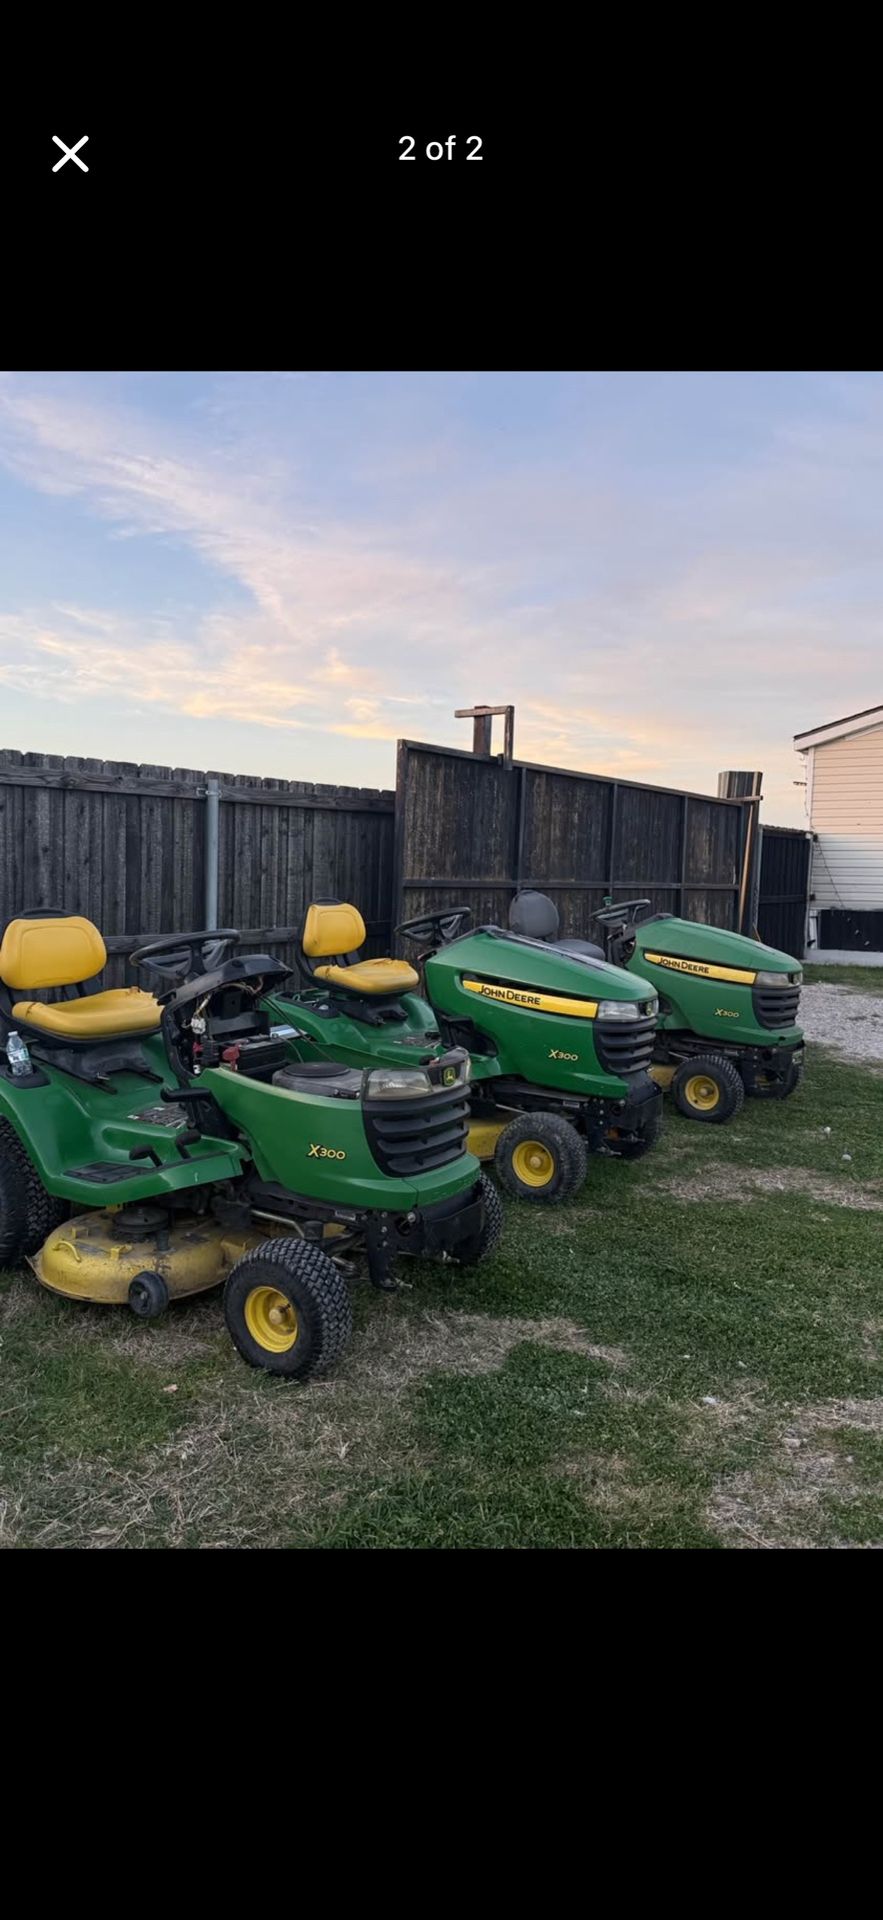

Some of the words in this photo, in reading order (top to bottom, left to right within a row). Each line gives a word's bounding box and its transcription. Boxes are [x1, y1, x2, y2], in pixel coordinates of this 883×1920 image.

[657, 957, 680, 968] JOHN
[681, 961, 710, 974] DEERE
[478, 984, 505, 998] JOHN
[506, 990, 541, 1005] DEERE
[714, 1008, 740, 1018] X300
[548, 1049, 579, 1061] X300
[307, 1143, 346, 1160] X300
